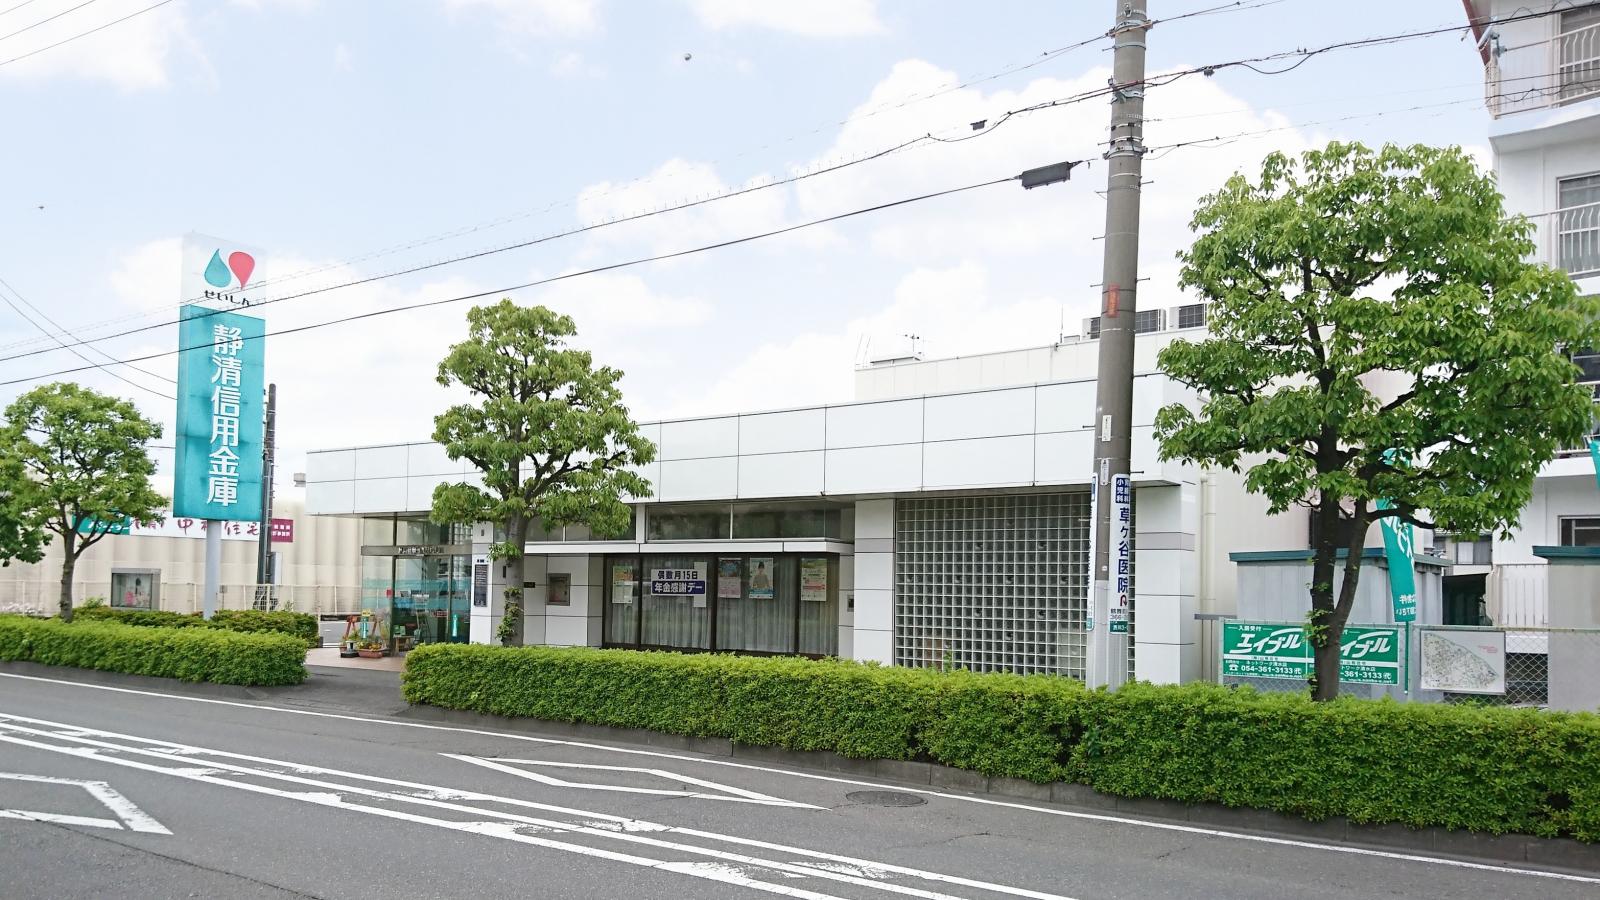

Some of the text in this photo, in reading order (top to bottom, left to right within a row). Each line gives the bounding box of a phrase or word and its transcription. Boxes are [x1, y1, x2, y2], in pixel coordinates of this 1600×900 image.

[204, 289, 252, 307] せいしん
[207, 323, 244, 507] 静清信用金庫
[657, 570, 698, 580] 偶数月15日
[654, 582, 703, 593] 年金感謝デー
[1229, 627, 1304, 654] エイブル
[1340, 630, 1394, 659] イブル
[1240, 665, 1293, 674] 054-361-3133
[1340, 670, 1382, 679] -361-3133
